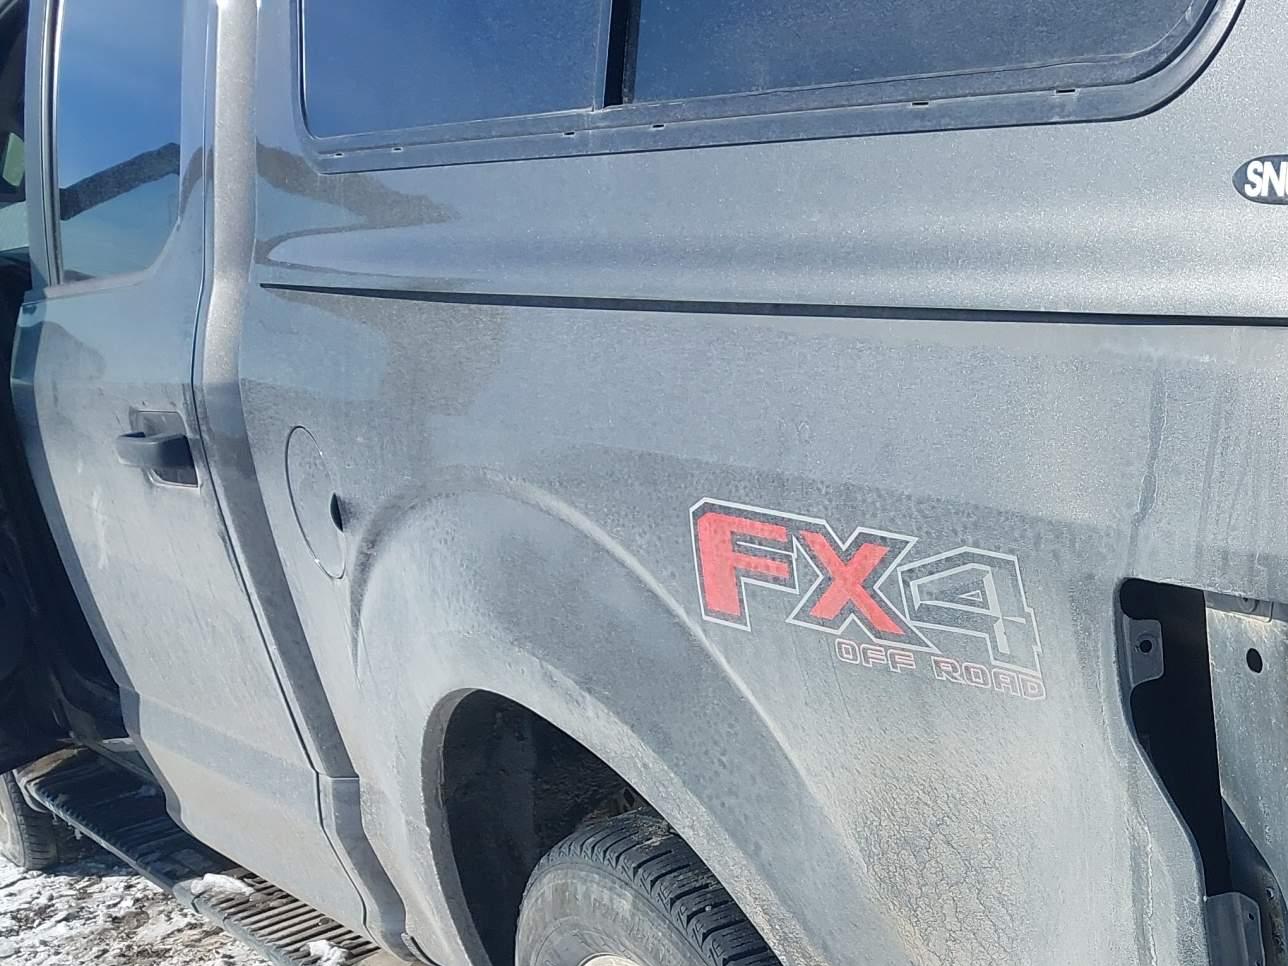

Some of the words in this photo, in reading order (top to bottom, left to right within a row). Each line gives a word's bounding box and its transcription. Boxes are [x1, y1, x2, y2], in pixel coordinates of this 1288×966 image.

[689, 497, 1042, 676] FX4
[834, 638, 917, 673] OFF
[931, 656, 1047, 701] ROAD
